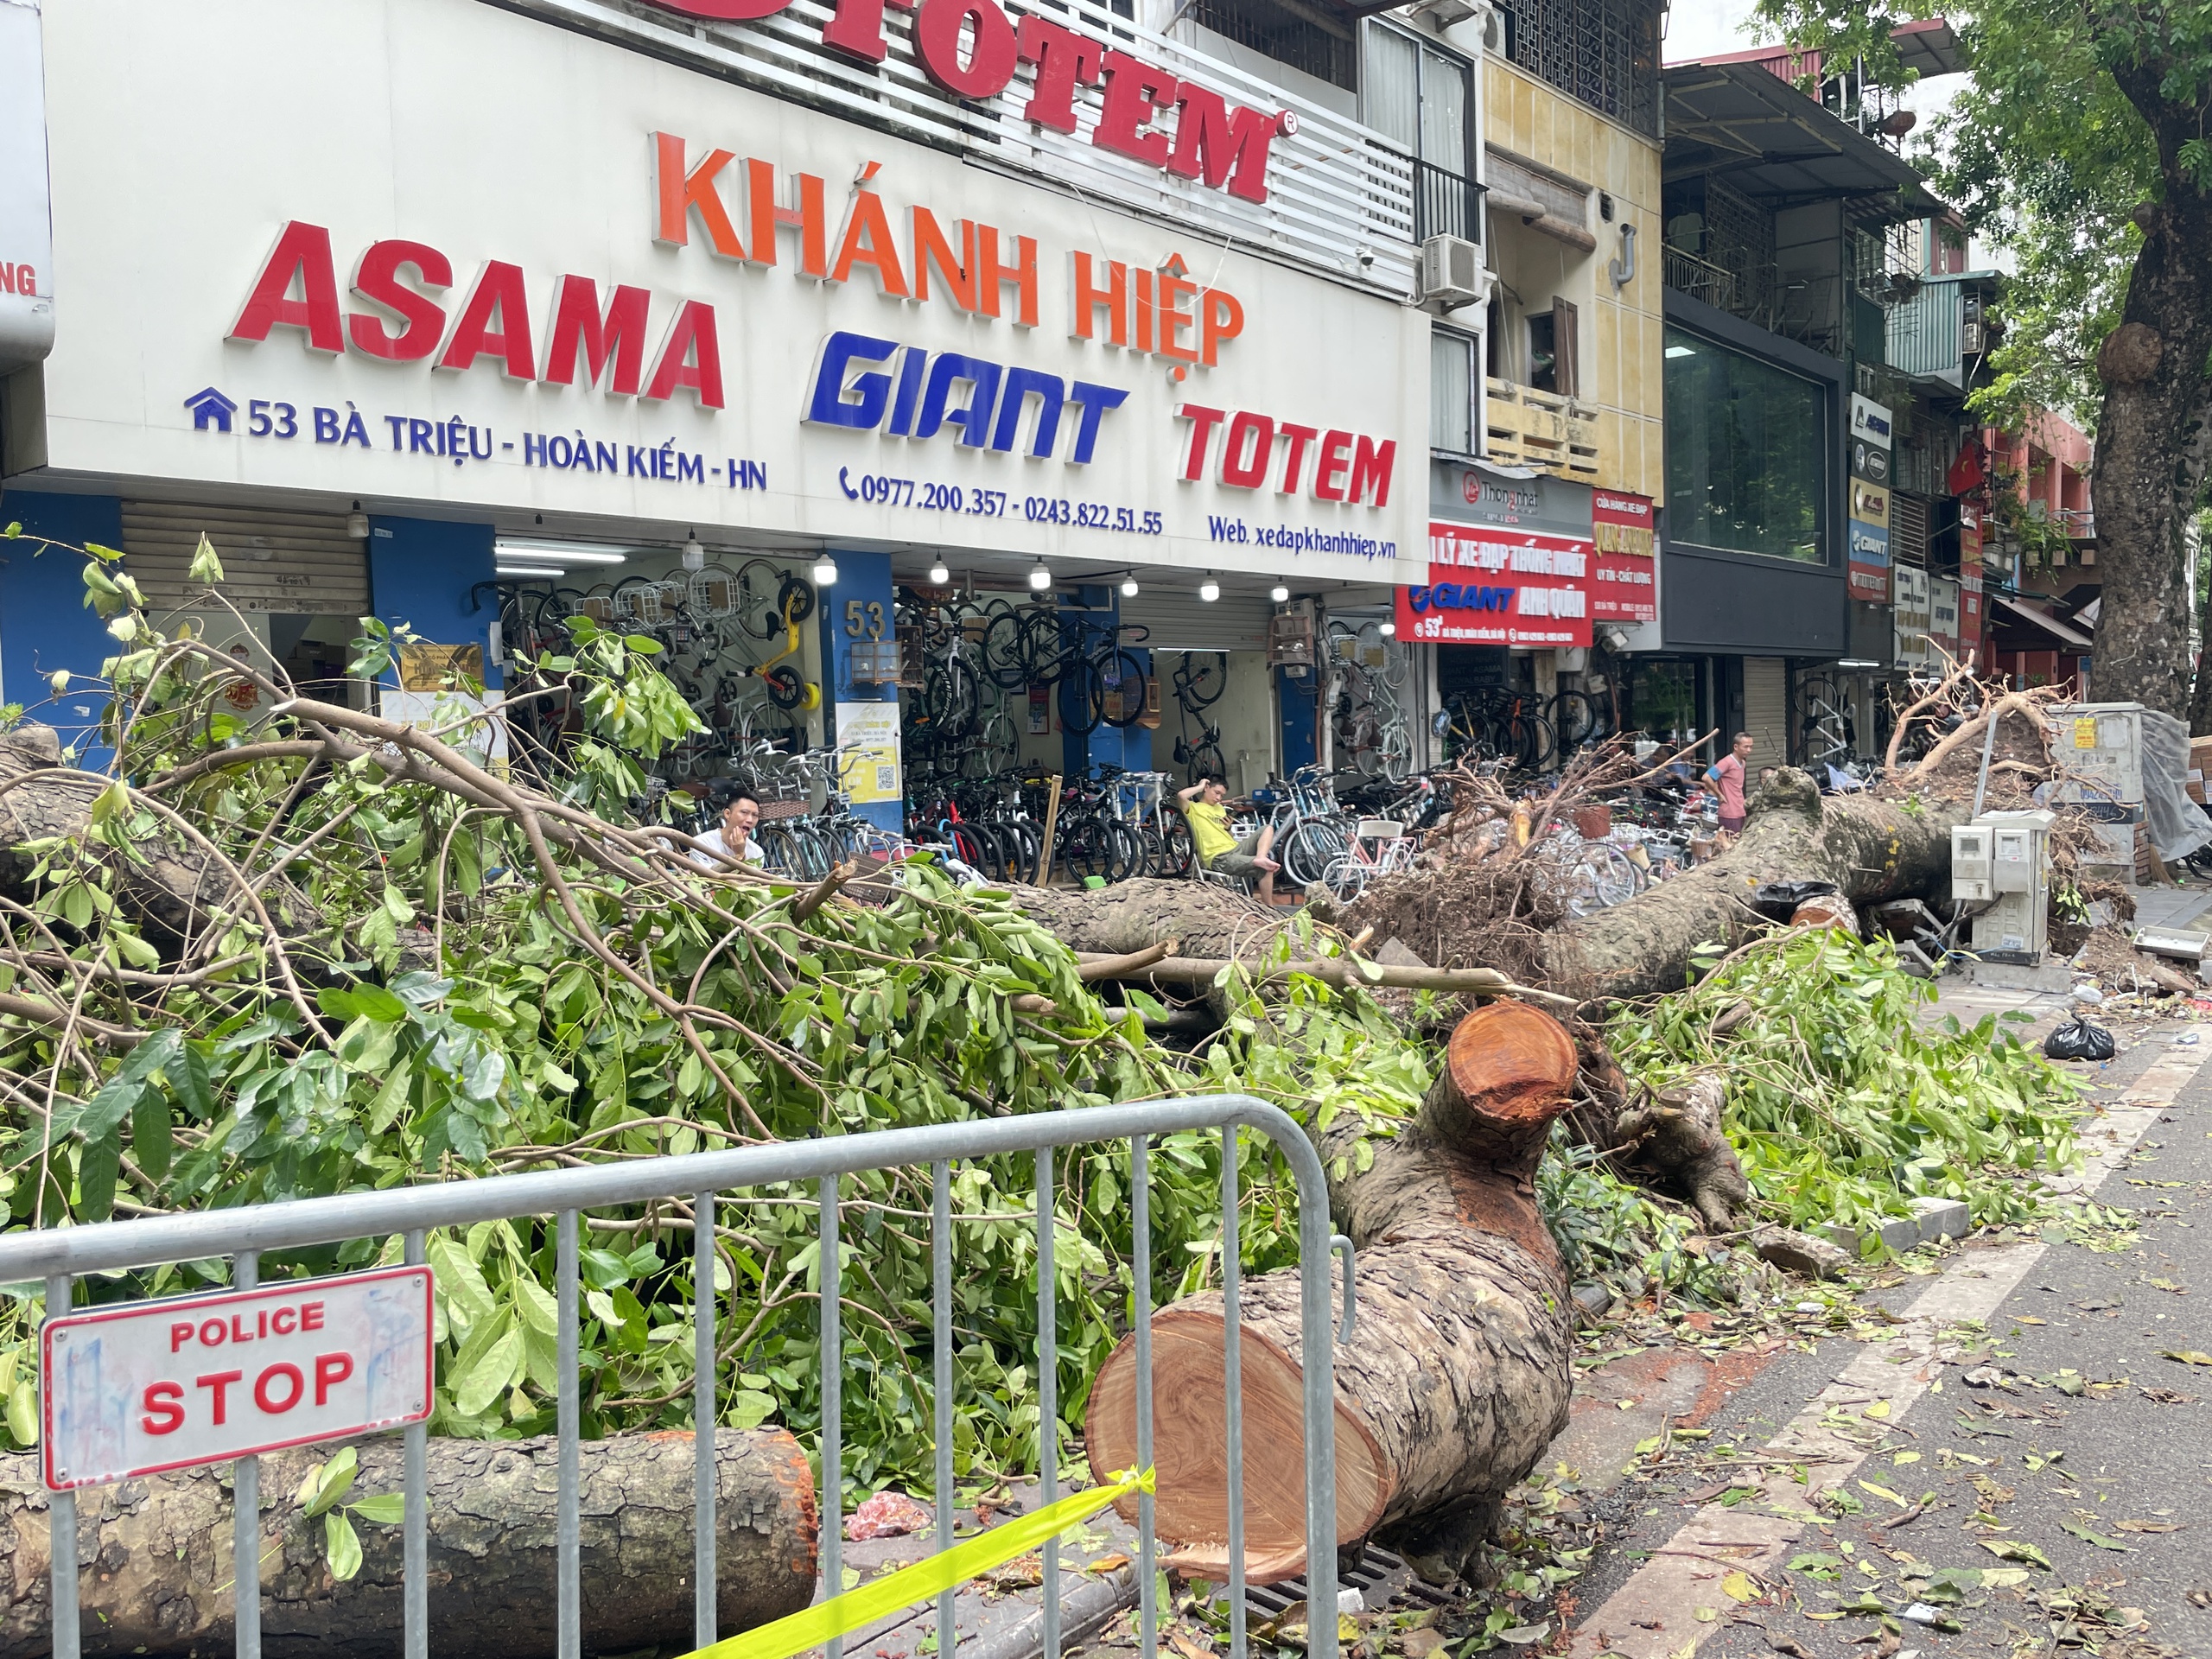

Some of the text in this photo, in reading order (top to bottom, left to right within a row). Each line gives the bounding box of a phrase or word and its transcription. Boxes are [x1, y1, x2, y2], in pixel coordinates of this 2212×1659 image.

[650, 130, 1245, 385] KHÁNH HIỆP
[225, 219, 725, 411] ASAMA
[802, 331, 1128, 467] GIANT
[250, 399, 298, 439] 53
[314, 401, 372, 447] BÀ
[385, 415, 493, 466] TRIỆU
[524, 429, 618, 474] HOÀN
[627, 437, 704, 484] KIẾM
[728, 458, 766, 491] HN
[1175, 403, 1396, 508] TOTEM
[861, 474, 1007, 518] 0977.200.357
[1026, 496, 1162, 536] 0243.822.51.55
[1209, 516, 1249, 544] Web.
[1255, 526, 1396, 562] xedapkhanhhiep.vn
[1458, 539, 1478, 566] XE
[1479, 542, 1508, 574] ĐẠP
[1860, 536, 1887, 555] GIANT
[844, 601, 886, 638] 53
[1433, 583, 1515, 611] GIANT
[170, 1300, 325, 1353] POLICE
[142, 1351, 354, 1435] STOP
